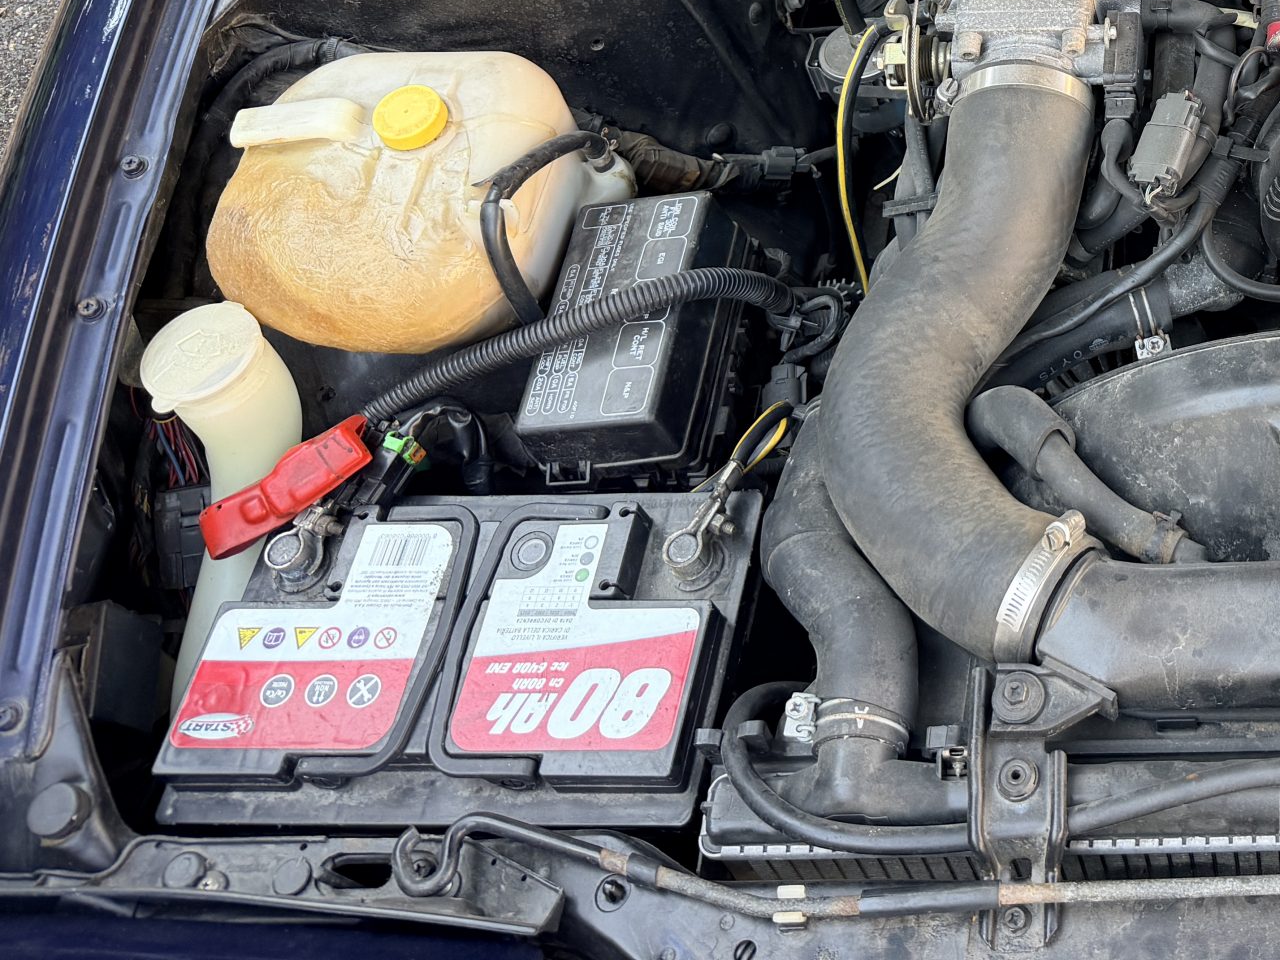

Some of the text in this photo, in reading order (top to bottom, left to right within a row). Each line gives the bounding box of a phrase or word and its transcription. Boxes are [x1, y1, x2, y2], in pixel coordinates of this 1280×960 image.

[639, 326, 650, 341] H/L
[628, 334, 641, 355] CONT
[634, 344, 645, 360] RET
[621, 380, 632, 398] N&P
[485, 667, 673, 739] 80 Ah
[182, 721, 233, 732] START
